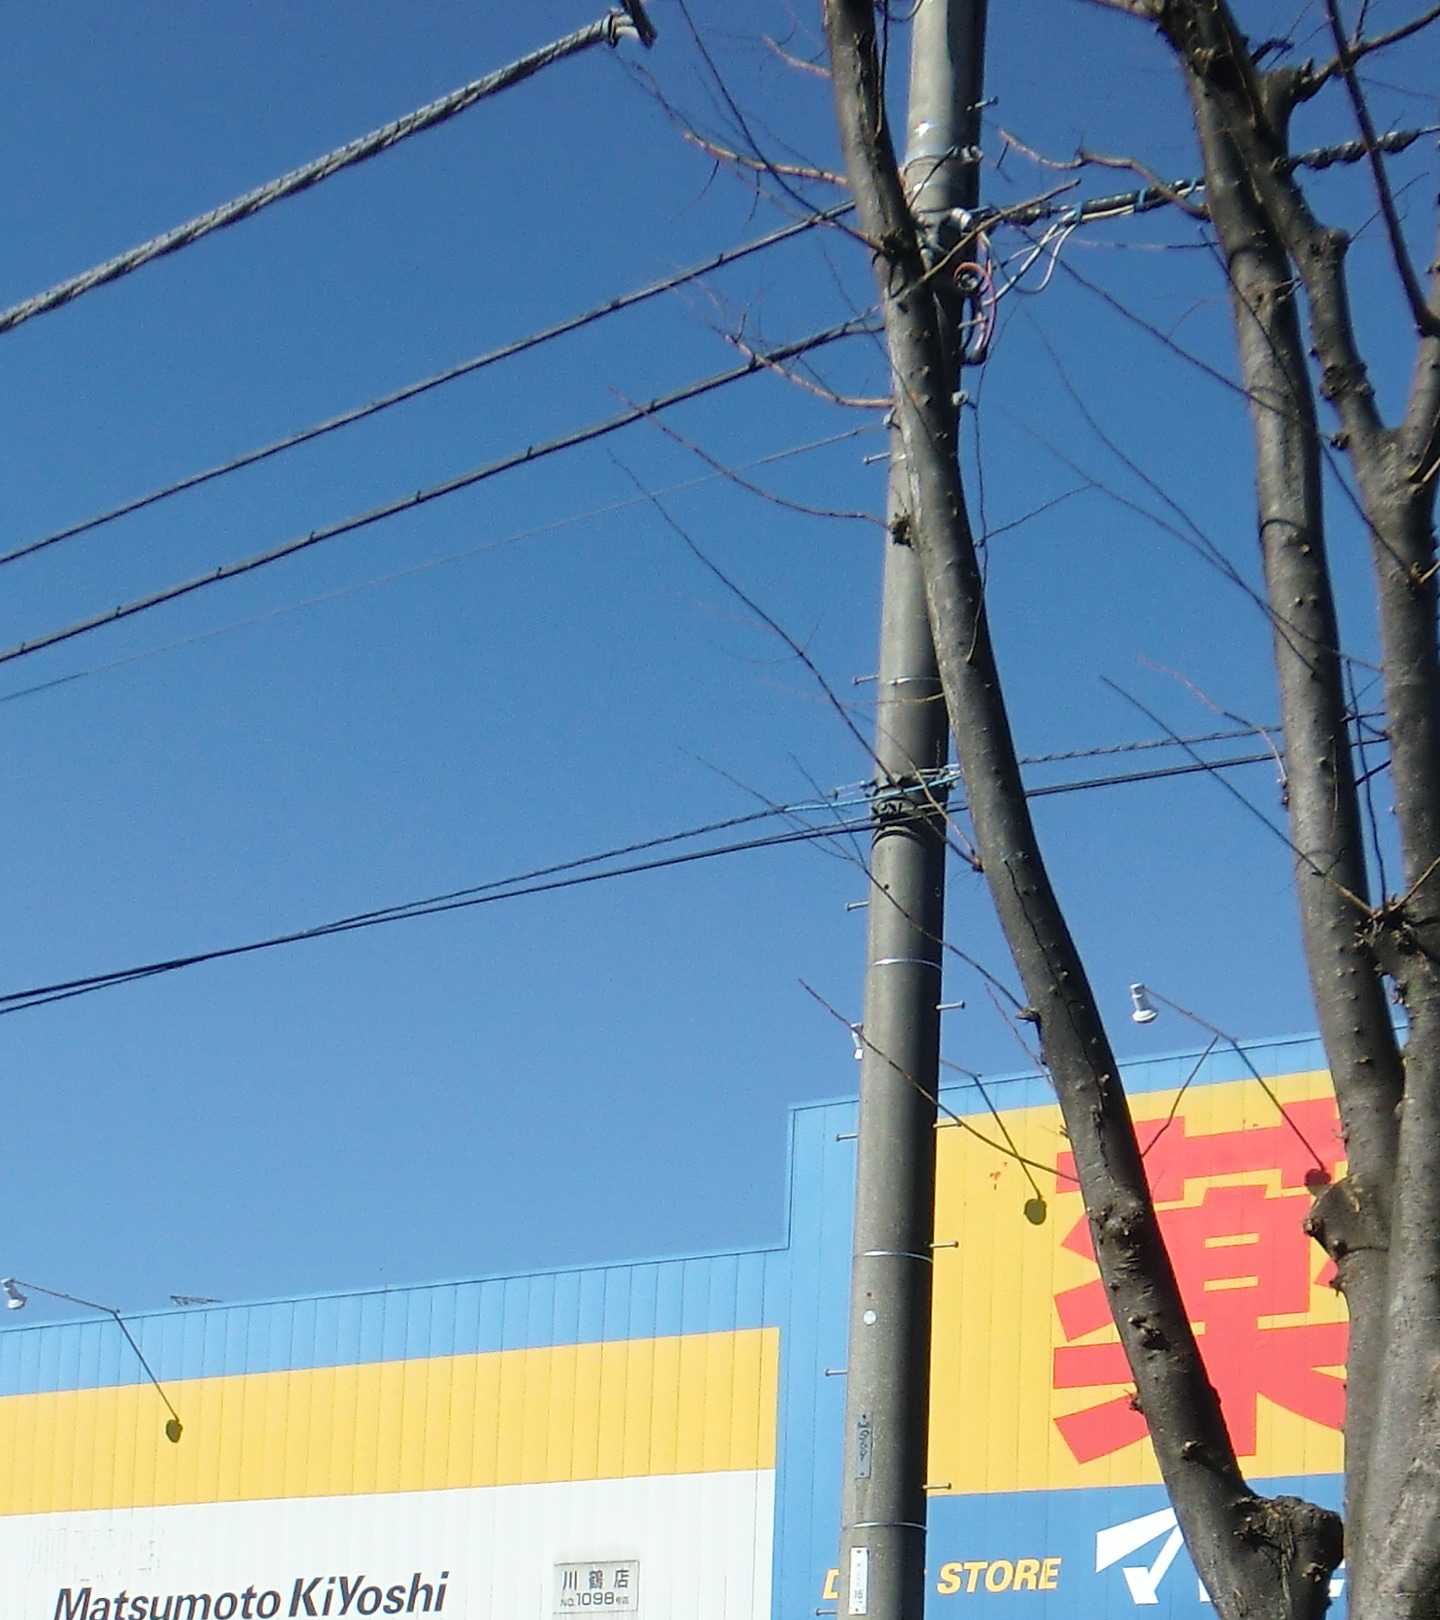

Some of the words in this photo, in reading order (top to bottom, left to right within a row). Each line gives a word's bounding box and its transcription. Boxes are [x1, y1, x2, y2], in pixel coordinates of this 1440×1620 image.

[1052, 1096, 1350, 1466] 薬
[288, 1570, 451, 1620] KiYoshi
[937, 1556, 1060, 1596] STORE
